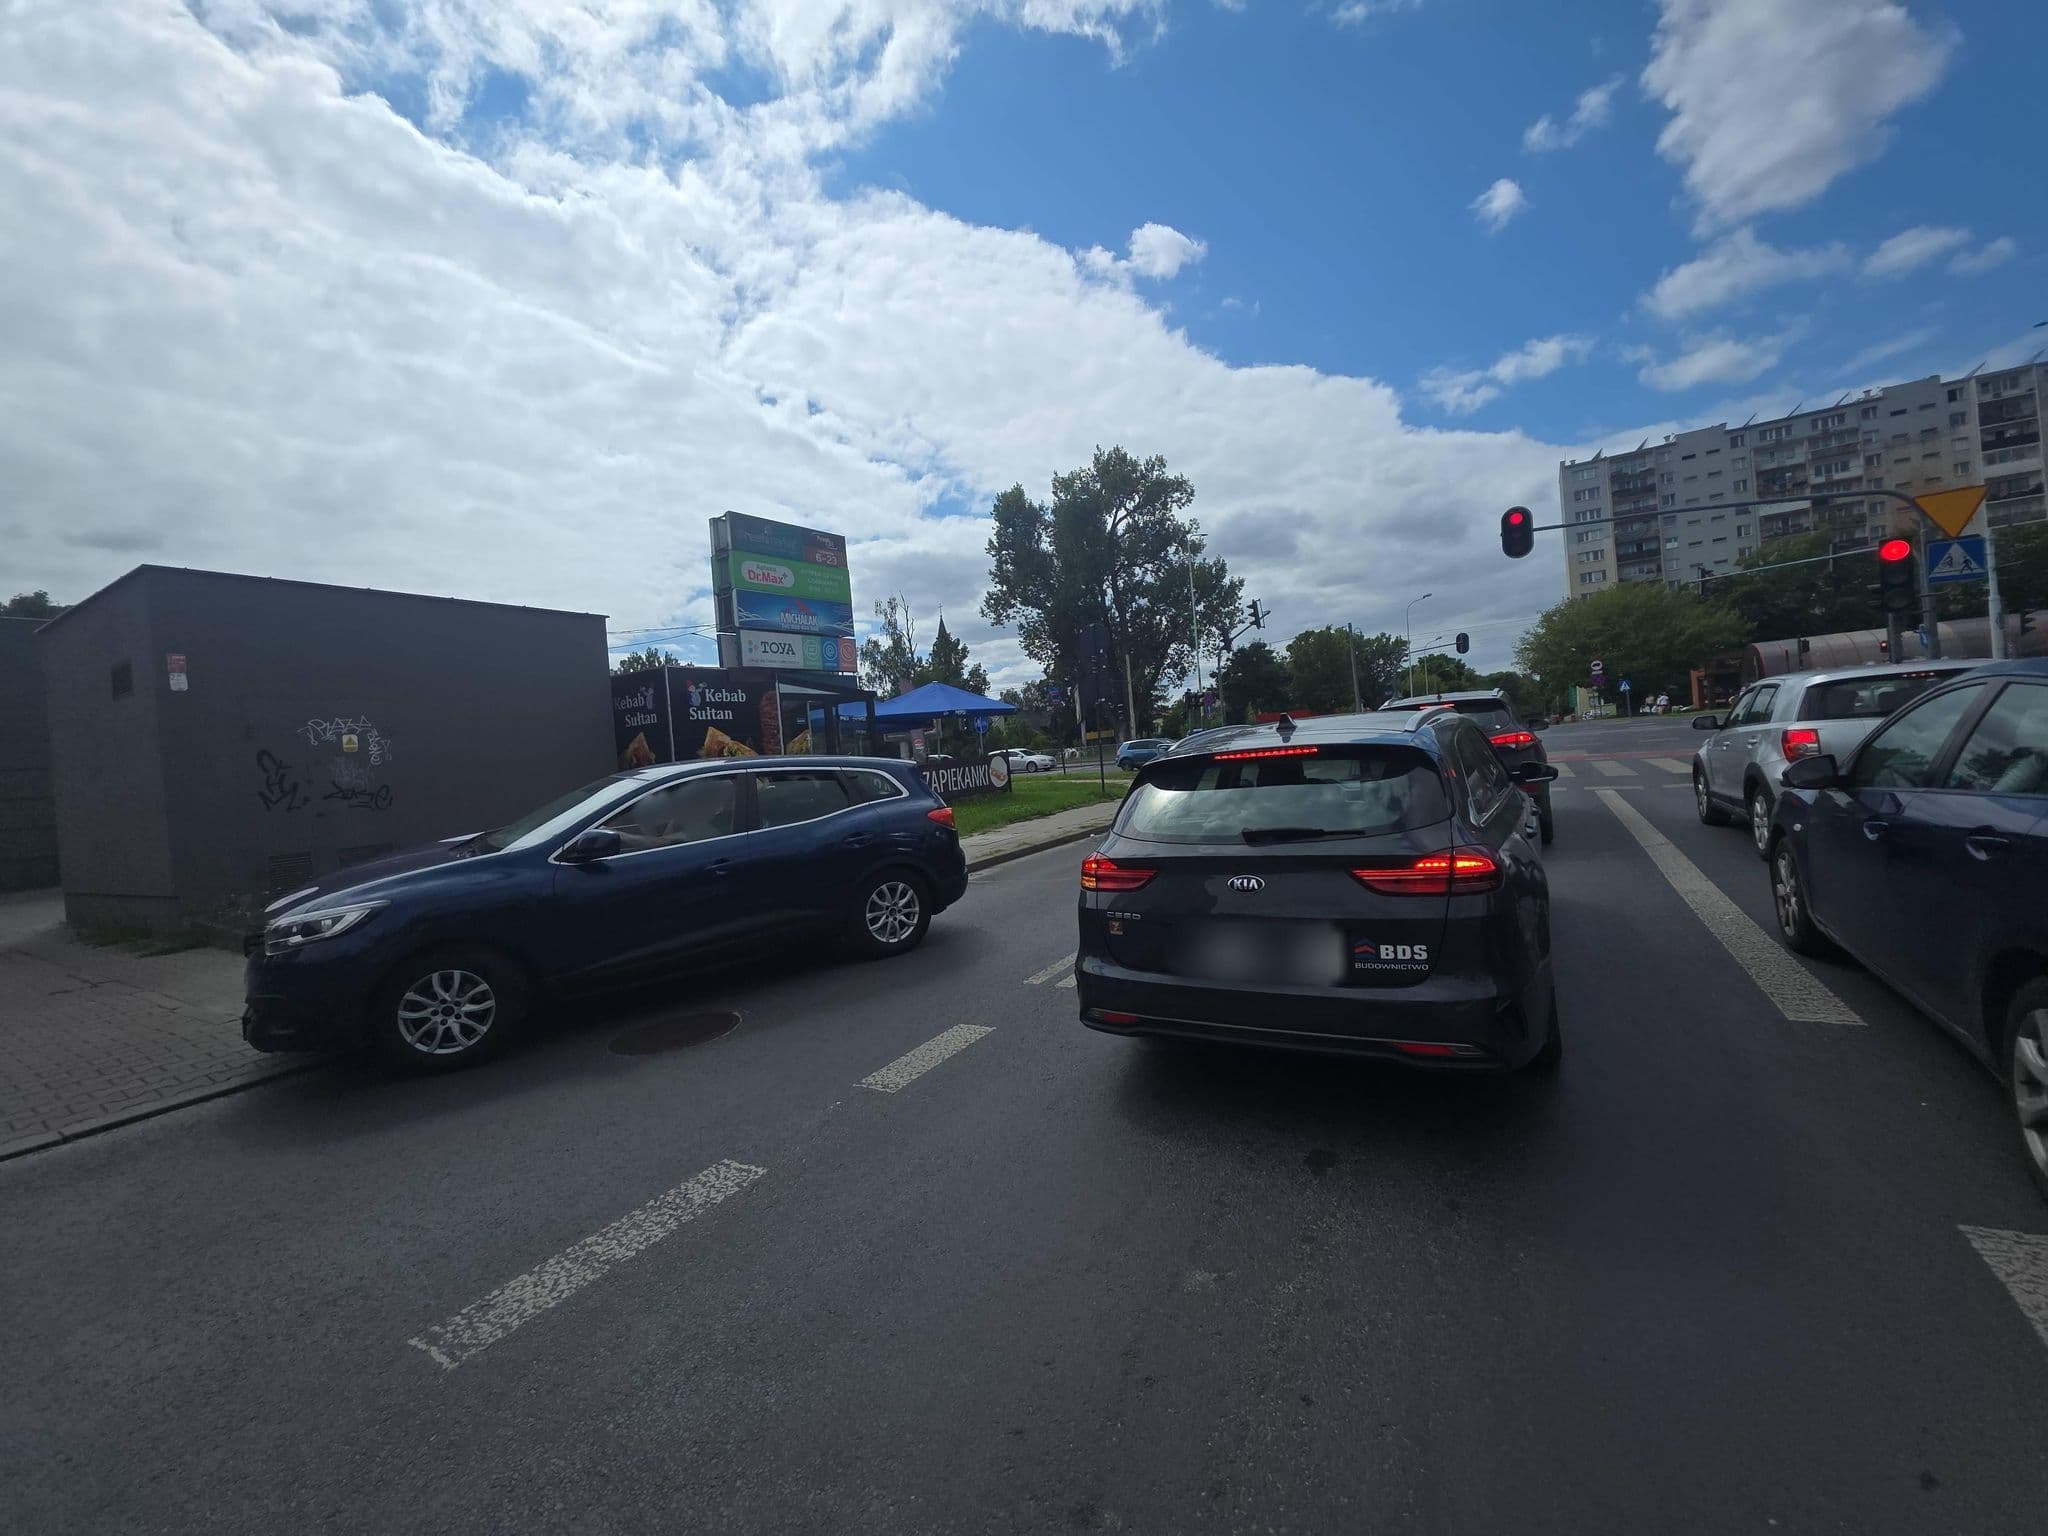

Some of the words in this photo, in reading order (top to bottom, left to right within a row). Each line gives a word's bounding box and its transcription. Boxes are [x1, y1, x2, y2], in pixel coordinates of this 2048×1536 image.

[748, 570, 784, 585] Dr.Max
[760, 641, 796, 656] TOYA
[614, 692, 645, 711] Kebab
[705, 688, 747, 703] Kebab
[624, 711, 658, 728] Sułtan
[689, 706, 734, 721] Sułtan
[1232, 878, 1259, 891] KIA
[1379, 944, 1429, 961] BDS
[1354, 962, 1430, 971] BUDOWNICTWO
